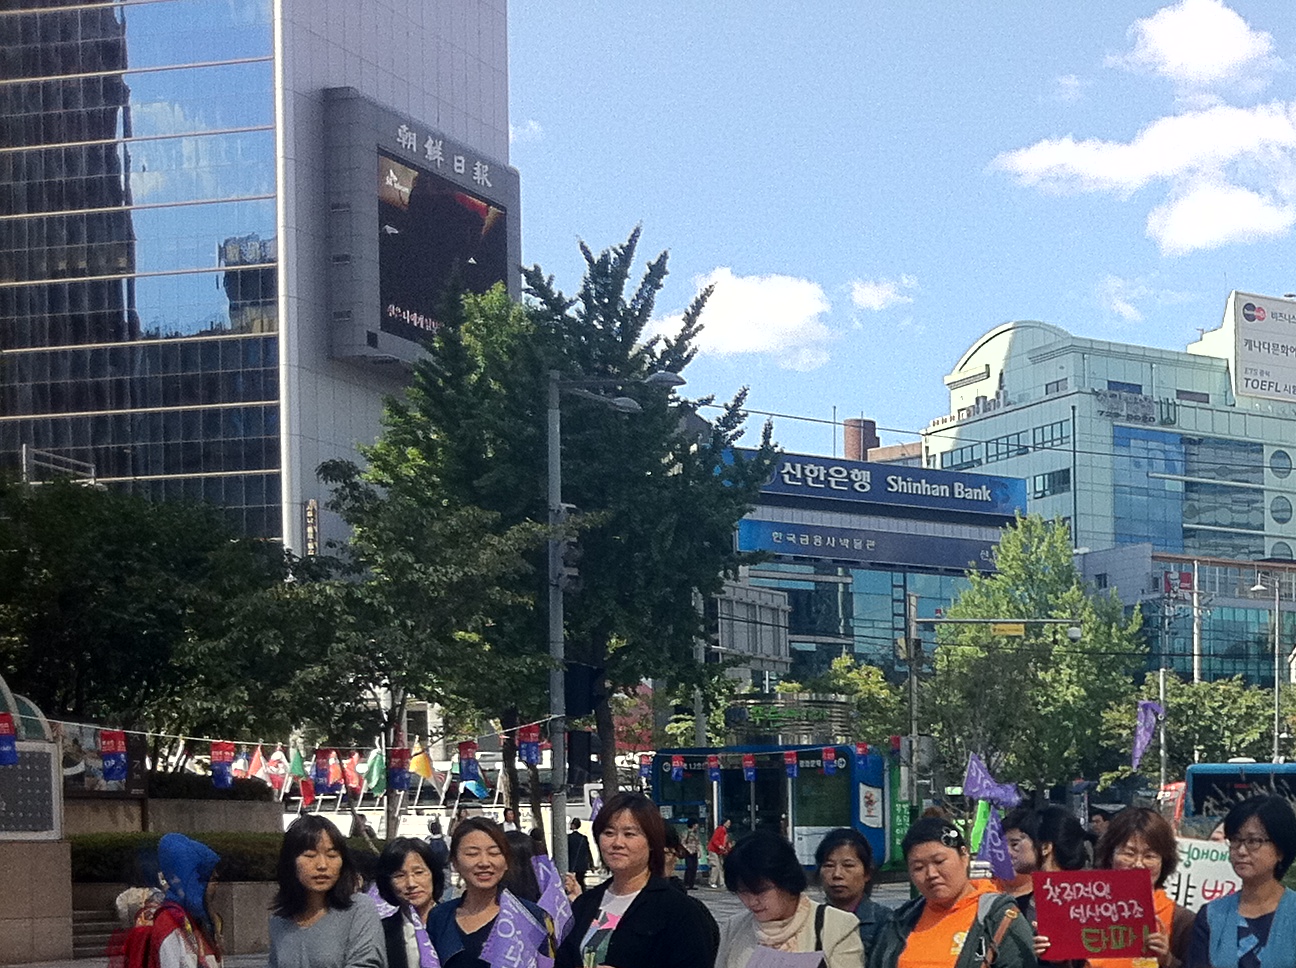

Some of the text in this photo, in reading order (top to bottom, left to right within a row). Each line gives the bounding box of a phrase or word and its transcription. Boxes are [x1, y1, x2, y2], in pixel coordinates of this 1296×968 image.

[396, 124, 492, 188] 朝鮮日報
[1244, 378, 1281, 393] TOEFL
[780, 462, 992, 502] 신한은행 Shinhan Bank
[772, 531, 876, 550] 한국금융사박물관
[1043, 878, 1112, 905] 착취적인
[1070, 900, 1144, 923] 성산업구조
